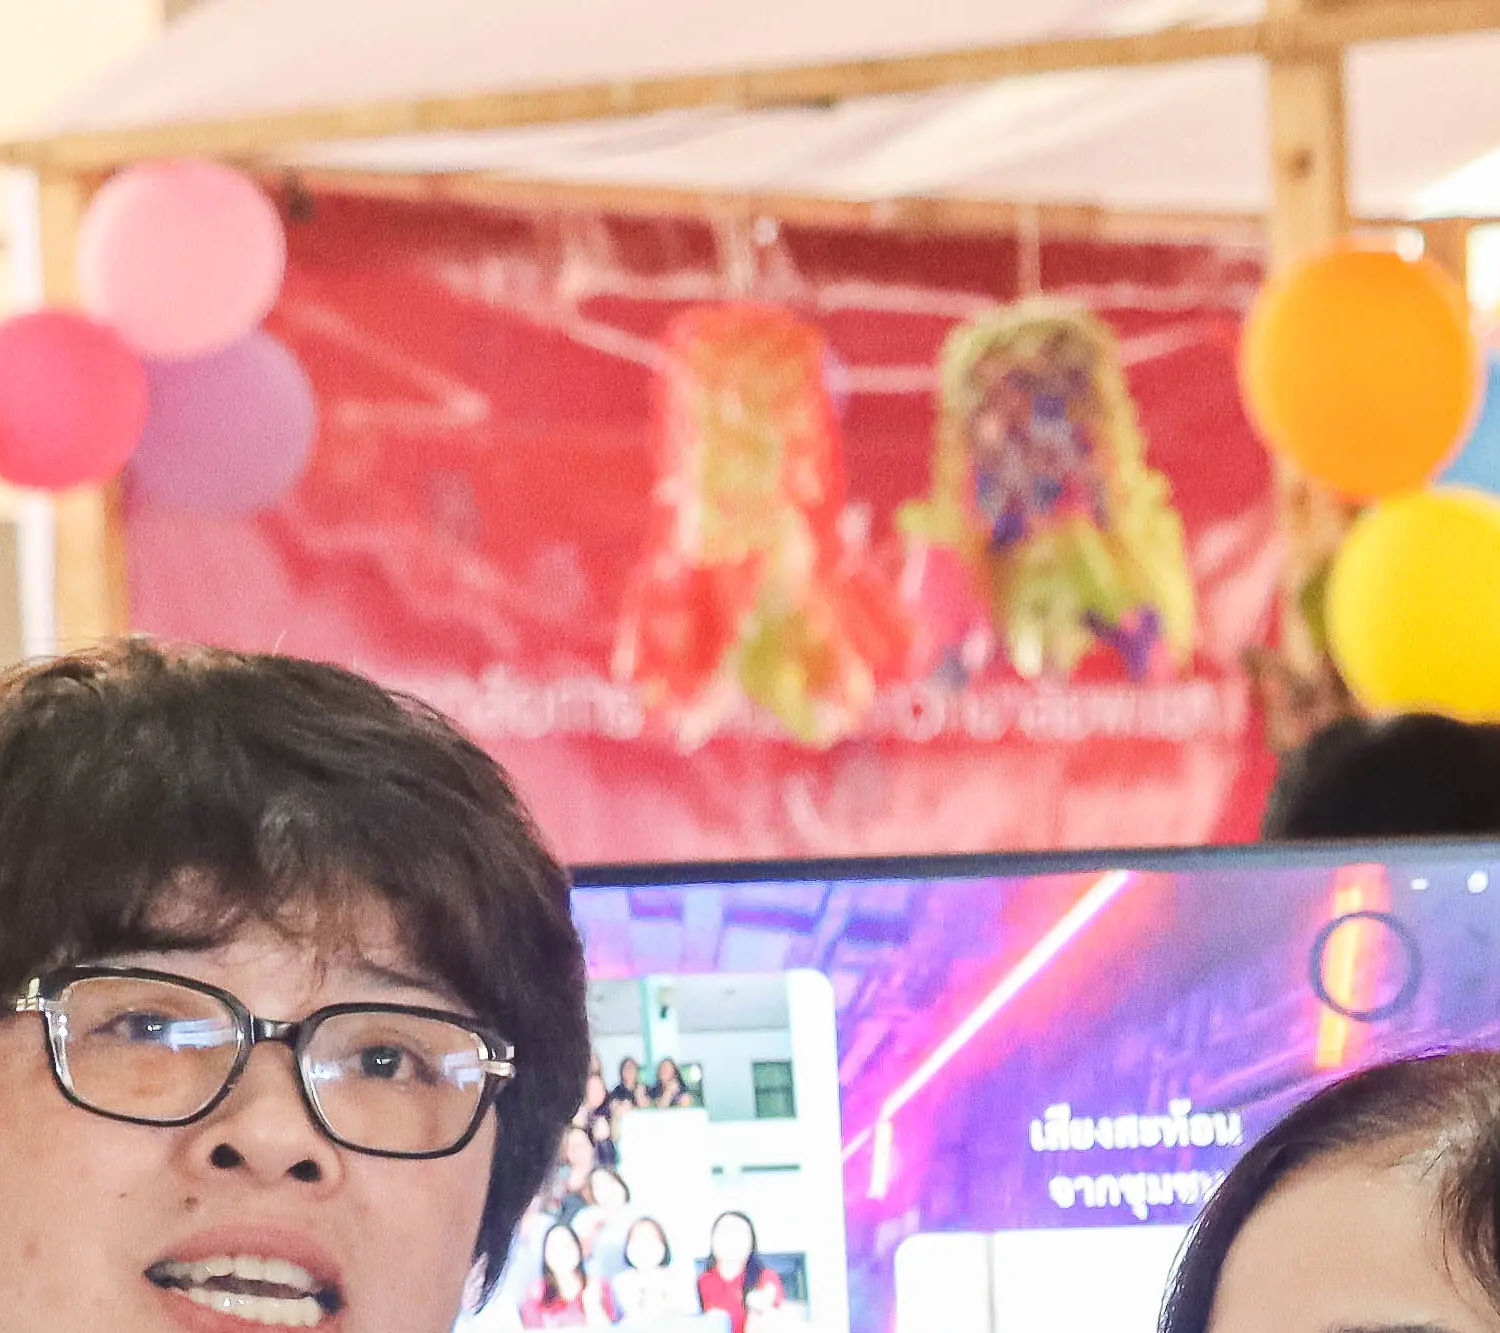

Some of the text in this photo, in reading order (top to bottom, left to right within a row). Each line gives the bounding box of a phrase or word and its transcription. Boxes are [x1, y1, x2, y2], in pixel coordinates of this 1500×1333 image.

[1029, 1098, 1244, 1152] เสียงสะท้อน
[1048, 1170, 1222, 1220] จากชุมช
